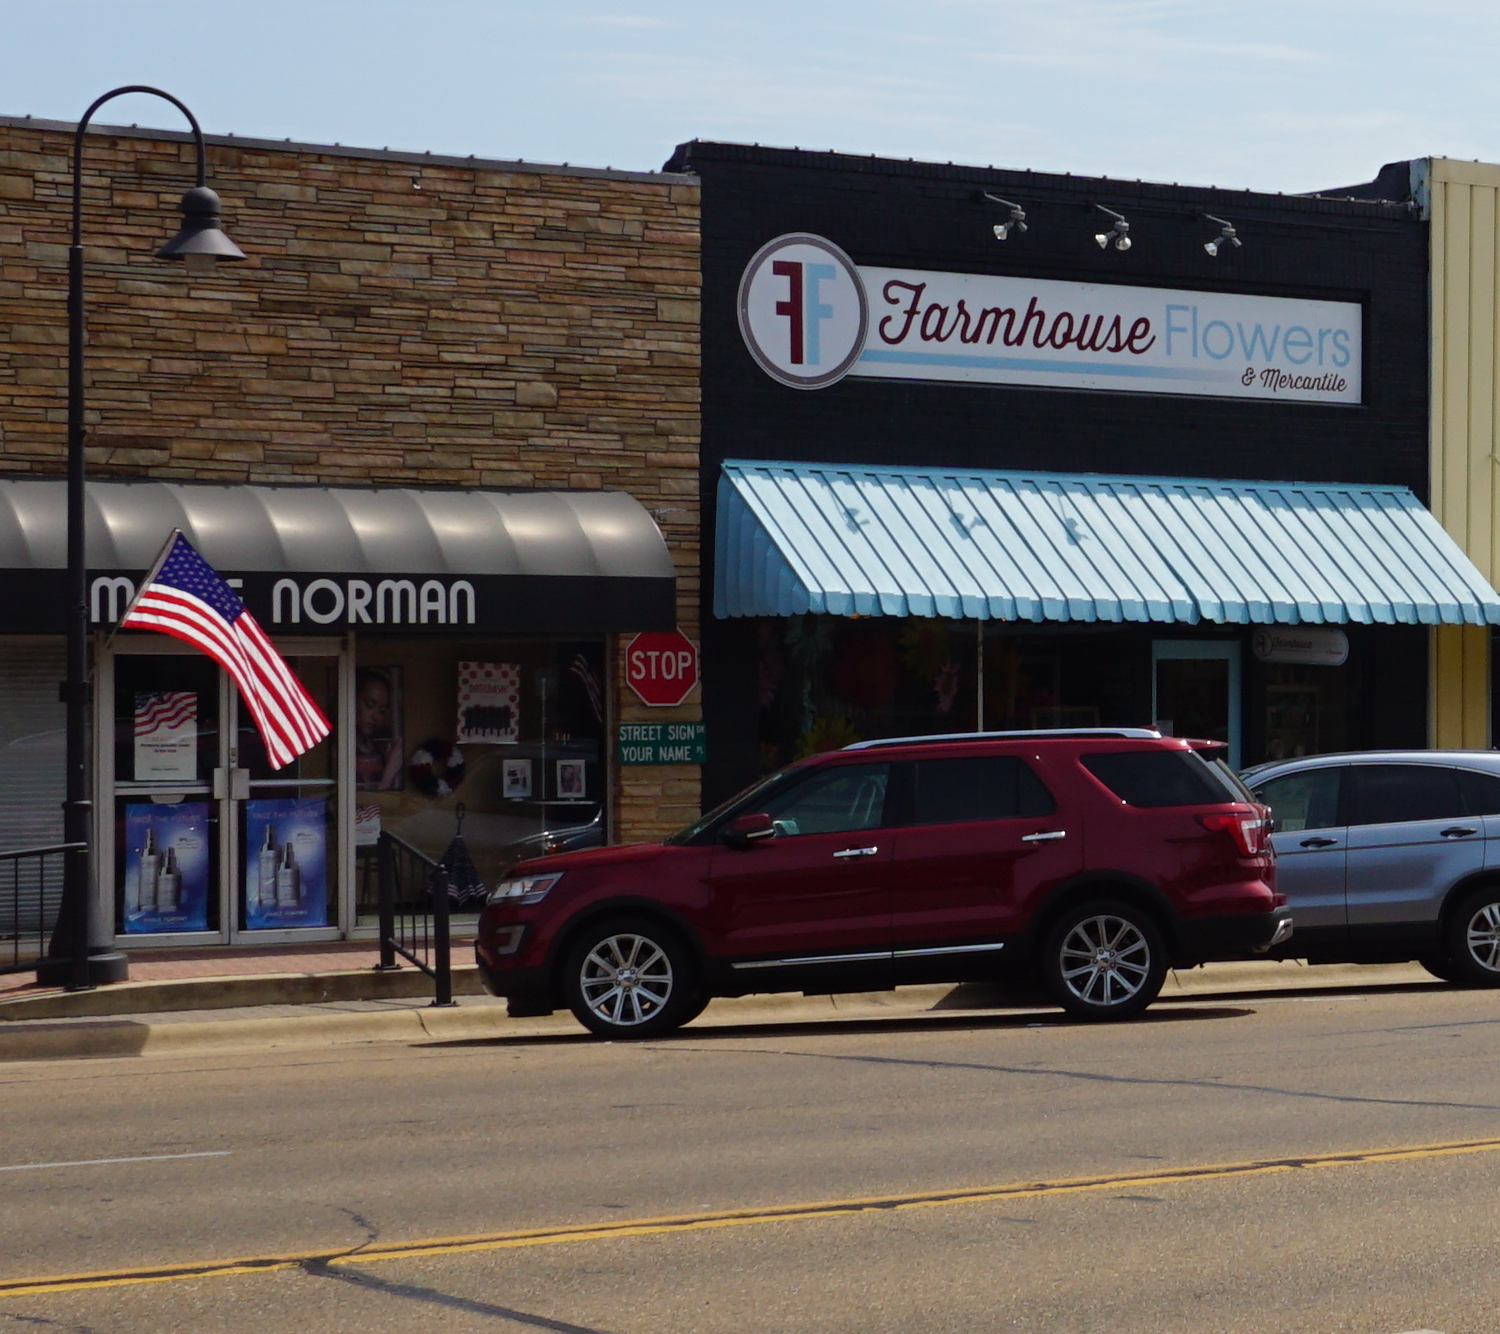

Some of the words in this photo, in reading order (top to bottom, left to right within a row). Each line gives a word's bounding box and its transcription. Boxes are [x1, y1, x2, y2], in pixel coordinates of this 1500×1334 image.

[879, 279, 1157, 355] Farmhouse
[1164, 304, 1352, 367] Flowers
[1241, 367, 1257, 387] &
[1260, 368, 1348, 393] Mercantile
[272, 578, 476, 624] NORMAN
[631, 650, 692, 680] STOP
[619, 725, 662, 741] STREET
[668, 725, 695, 741] SIGN
[621, 746, 653, 762] YOUR
[659, 745, 691, 761] NAME
